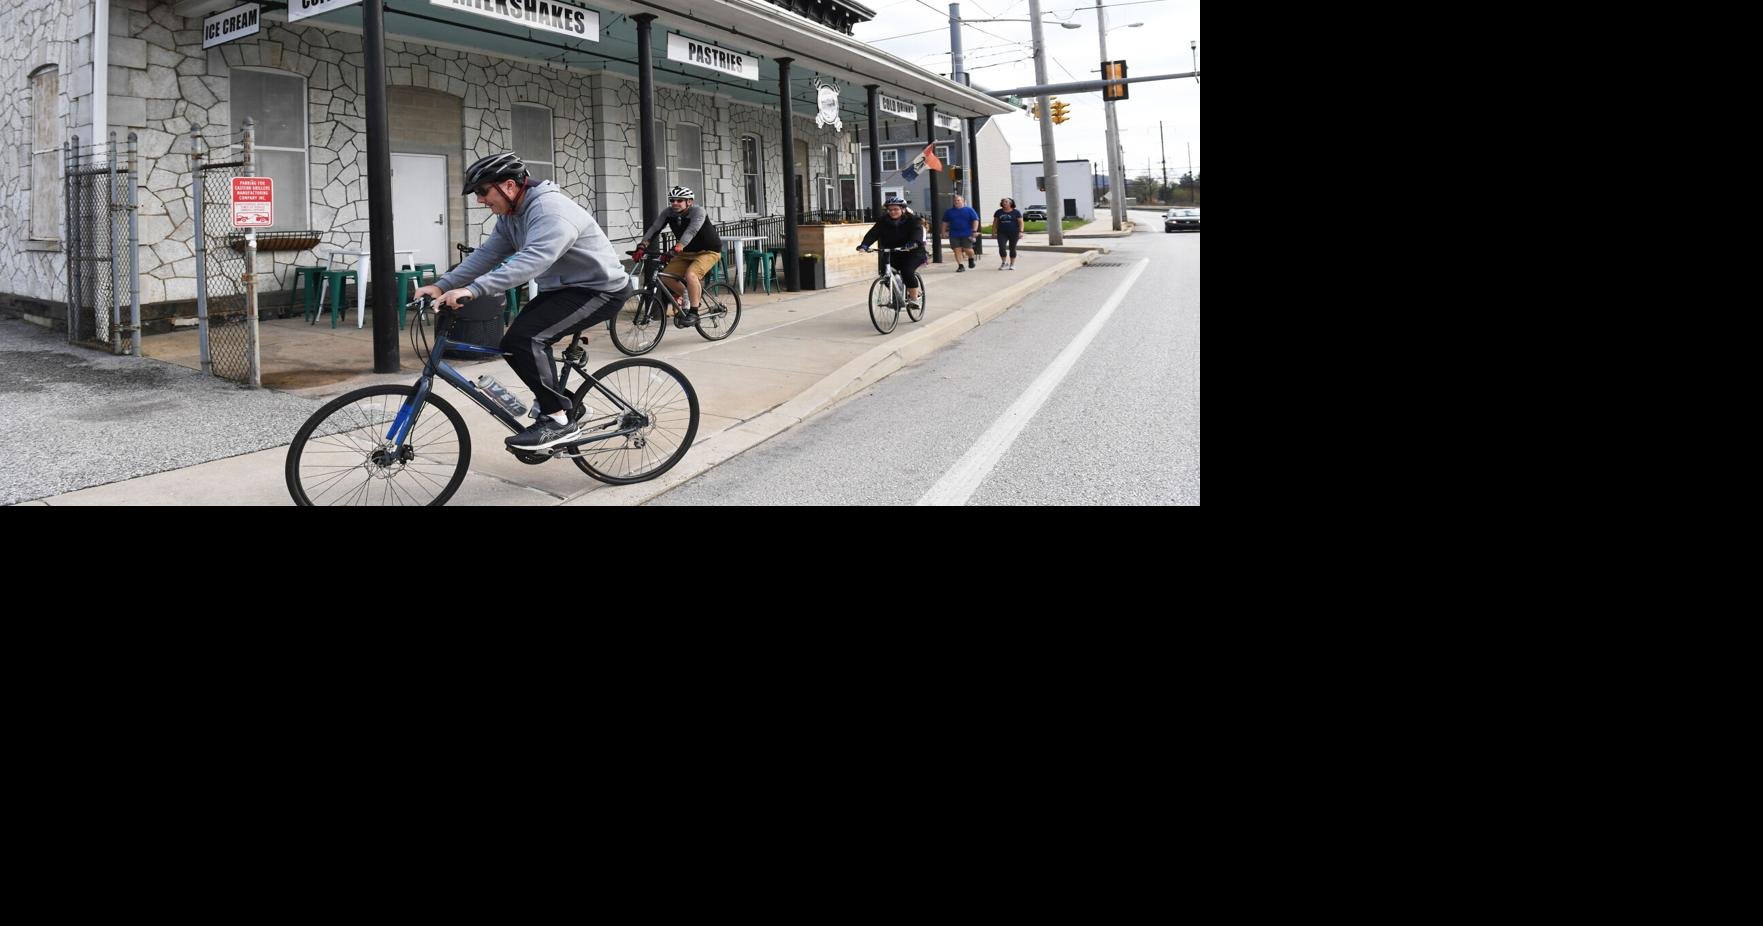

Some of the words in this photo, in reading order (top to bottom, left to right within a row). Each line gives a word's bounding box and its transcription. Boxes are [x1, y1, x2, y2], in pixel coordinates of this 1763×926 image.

[205, 21, 220, 41] ICE
[222, 8, 258, 35] CREAM
[452, 0, 585, 34] LKSHAKES
[688, 42, 743, 73] PASTRIES
[882, 97, 897, 112] COLD
